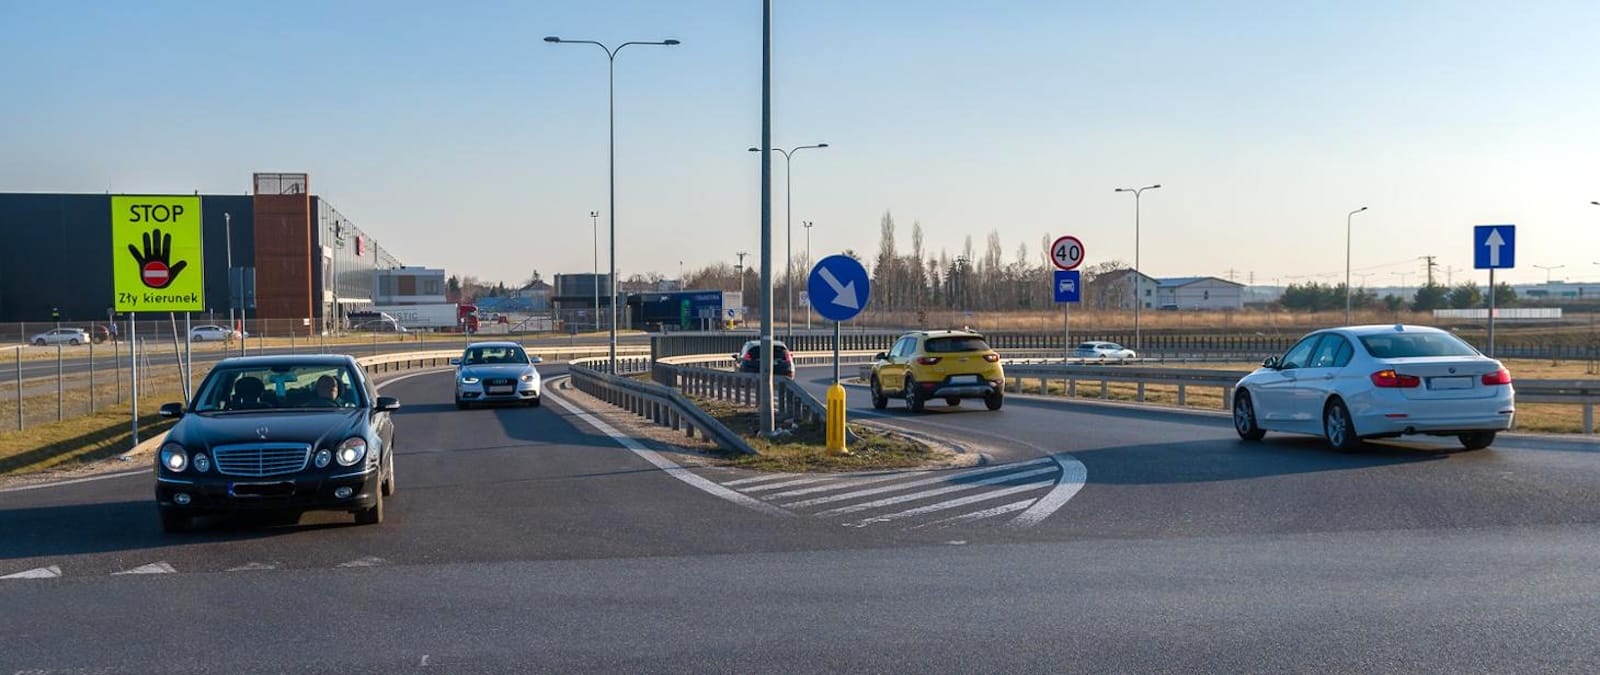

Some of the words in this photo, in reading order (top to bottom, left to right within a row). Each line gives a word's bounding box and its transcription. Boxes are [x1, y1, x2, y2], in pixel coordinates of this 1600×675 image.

[129, 205, 184, 223] STOP
[1056, 245, 1080, 261] 40
[119, 293, 138, 306] Zły
[143, 293, 198, 304] kierunek
